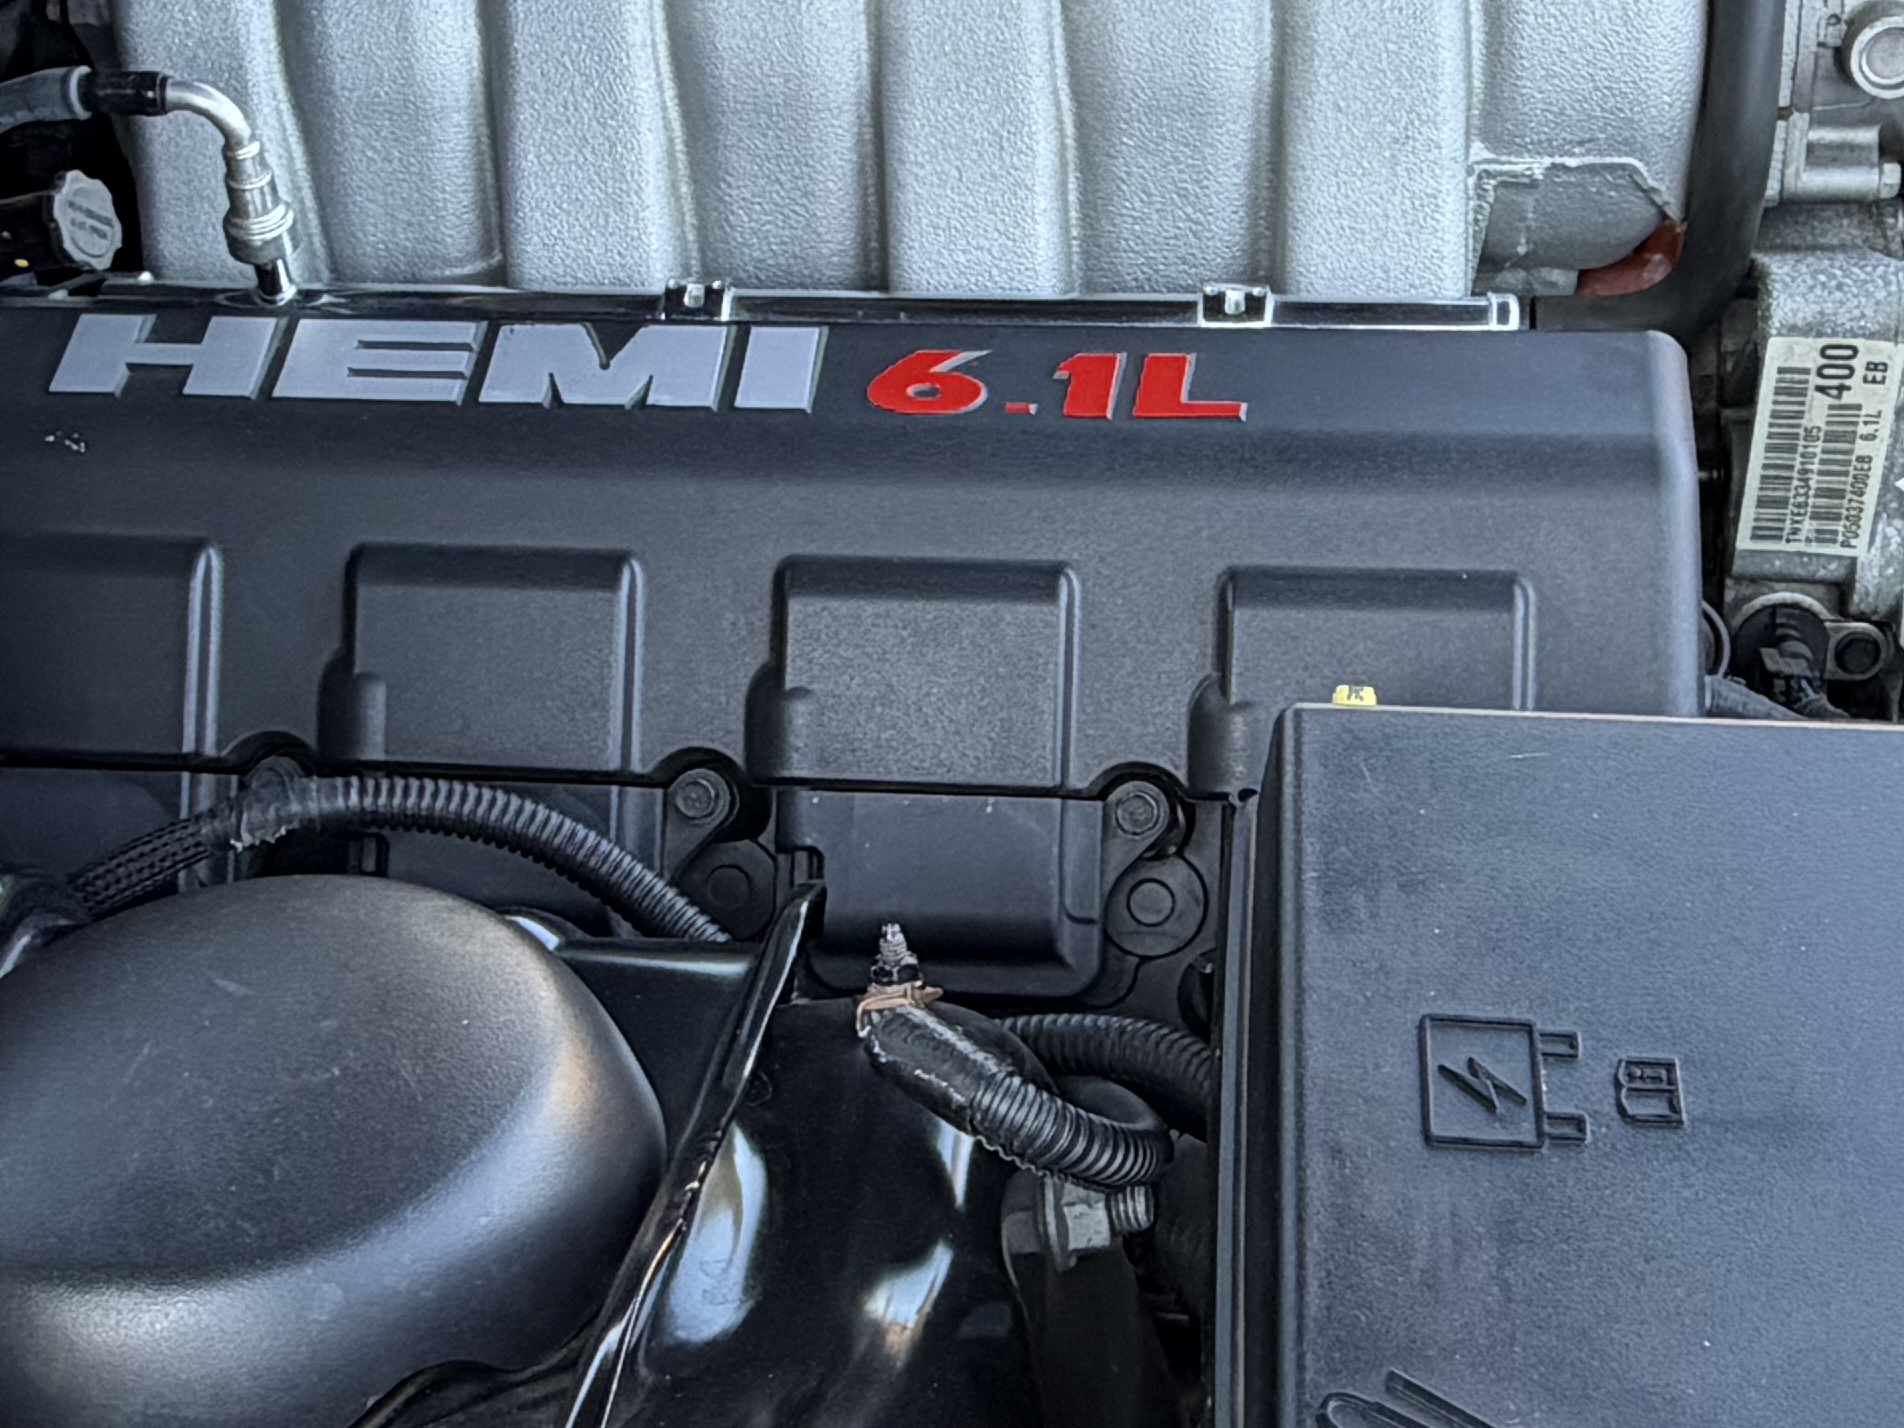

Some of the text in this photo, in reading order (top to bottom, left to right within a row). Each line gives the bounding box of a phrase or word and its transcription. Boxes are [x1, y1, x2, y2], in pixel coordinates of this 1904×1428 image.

[48, 312, 1247, 421] HEMI 6.1L
[1814, 343, 1860, 401] 400
[1863, 360, 1888, 387] EB
[1859, 409, 1882, 442] 6.1L
